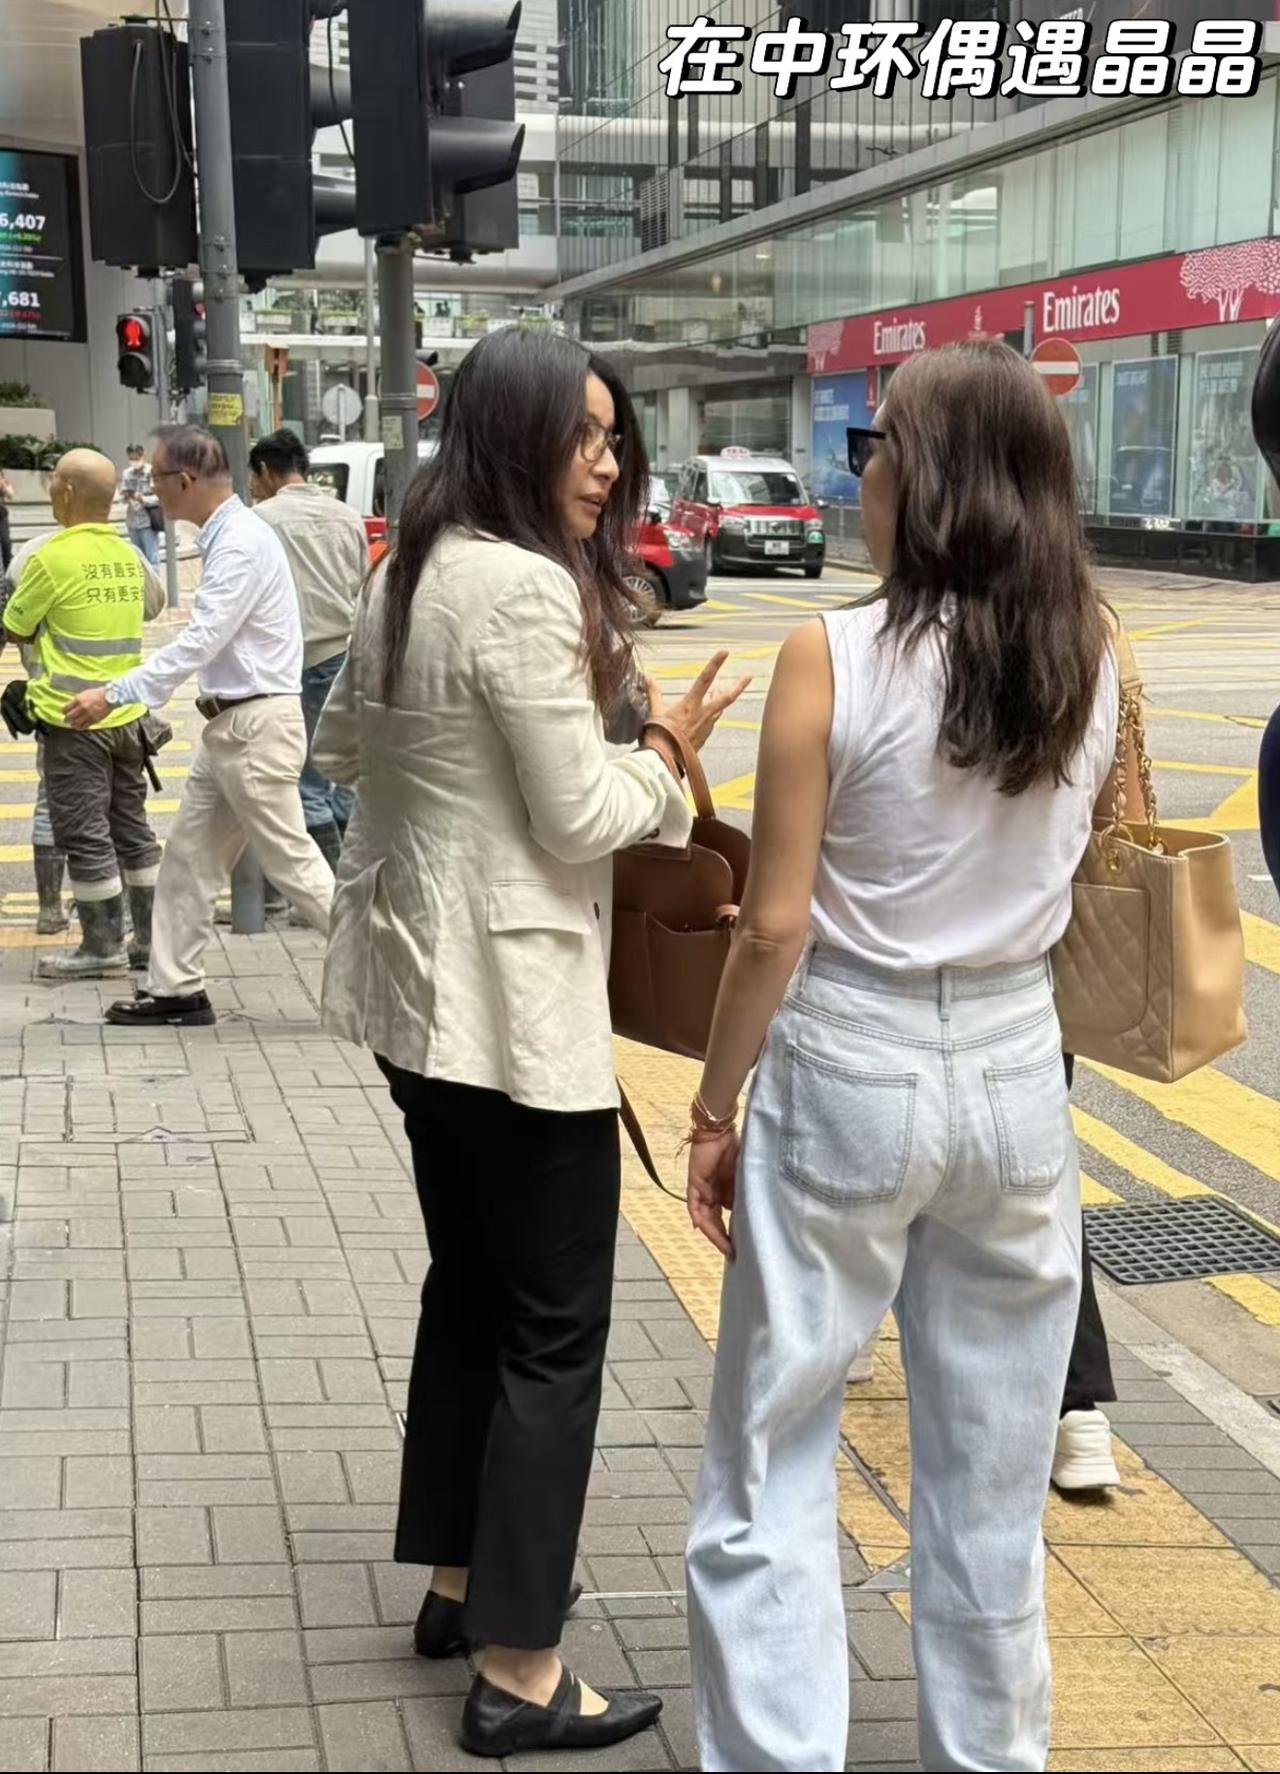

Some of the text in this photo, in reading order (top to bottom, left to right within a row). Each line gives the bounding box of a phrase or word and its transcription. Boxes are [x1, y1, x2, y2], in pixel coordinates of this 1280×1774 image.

[0, 291, 40, 307] ,681
[1042, 285, 1121, 333] Emirates
[873, 317, 926, 355] Emirates
[87, 585, 144, 603] 只有更安
